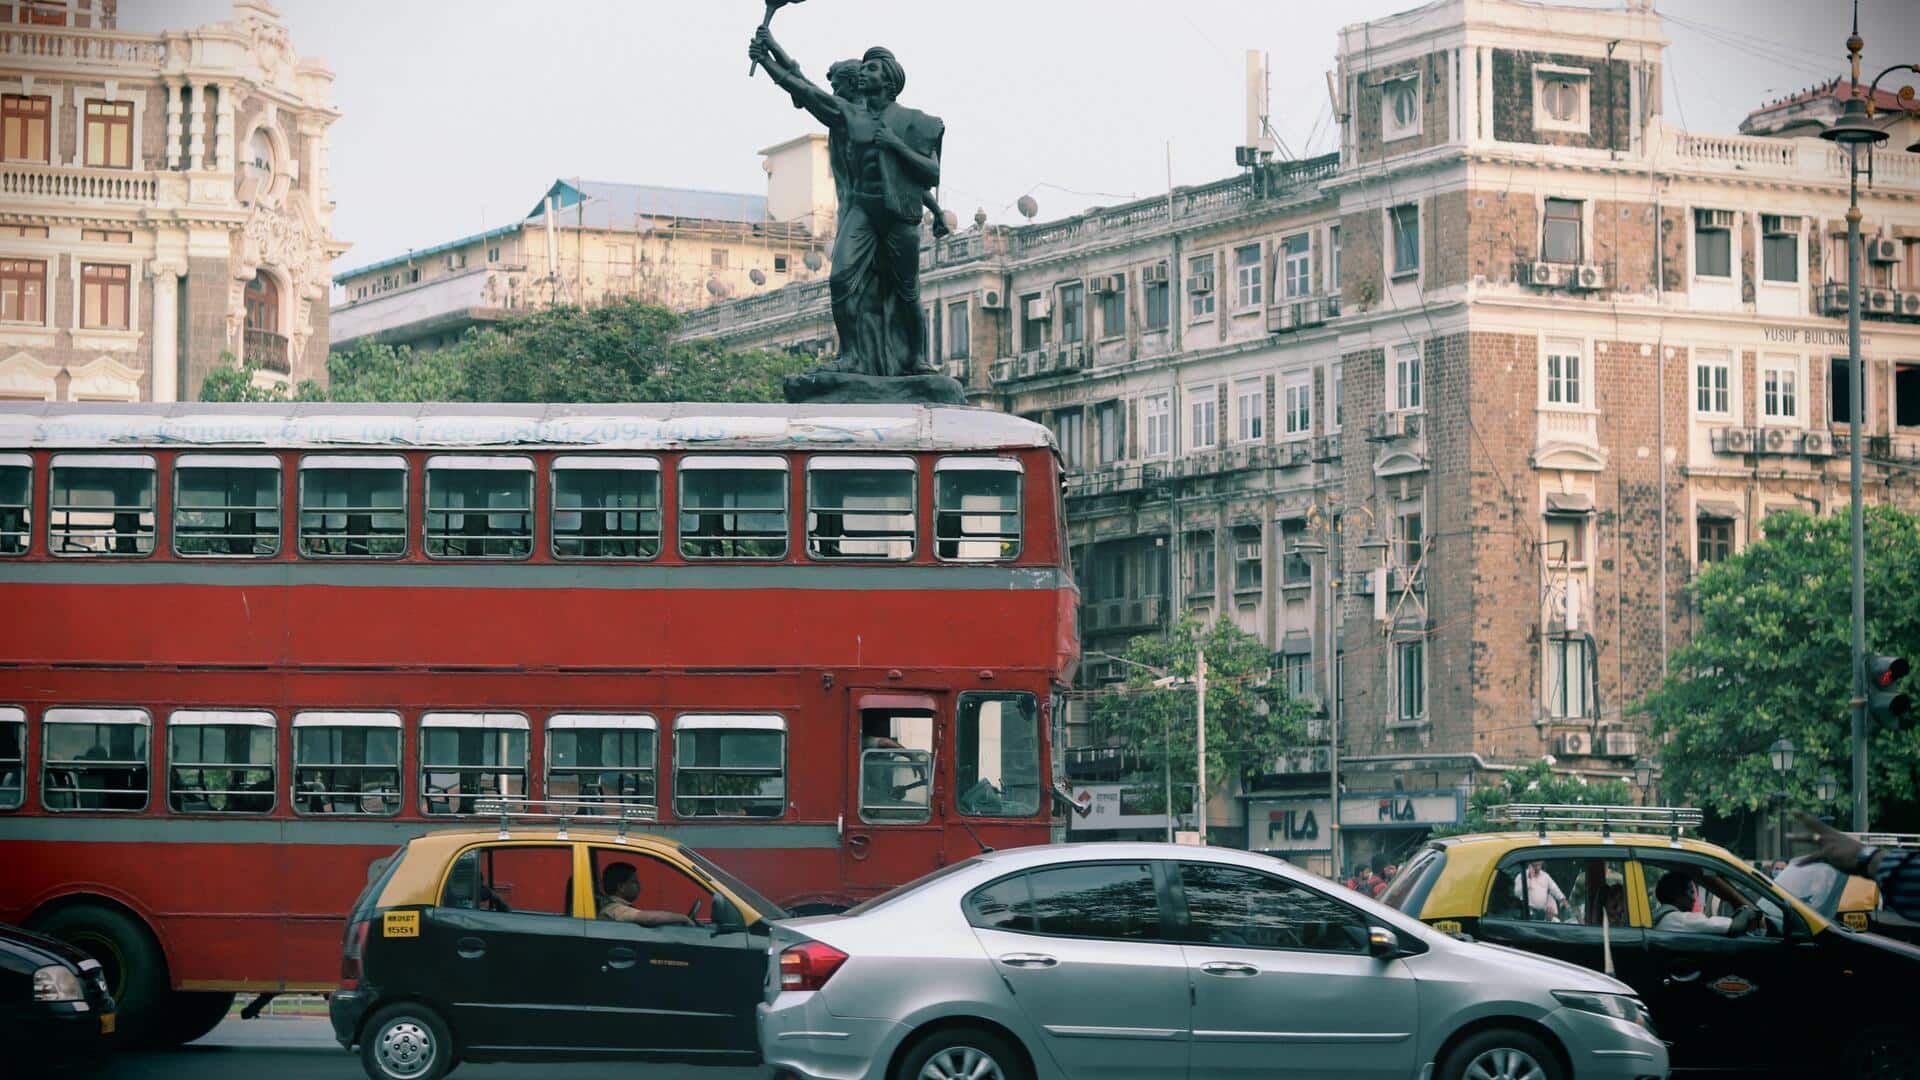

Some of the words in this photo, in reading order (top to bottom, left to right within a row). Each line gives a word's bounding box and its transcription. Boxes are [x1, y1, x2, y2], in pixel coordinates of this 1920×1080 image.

[1763, 327, 1798, 344] YUSUF
[1379, 799, 1416, 821] FILA
[1269, 810, 1319, 841] FILA
